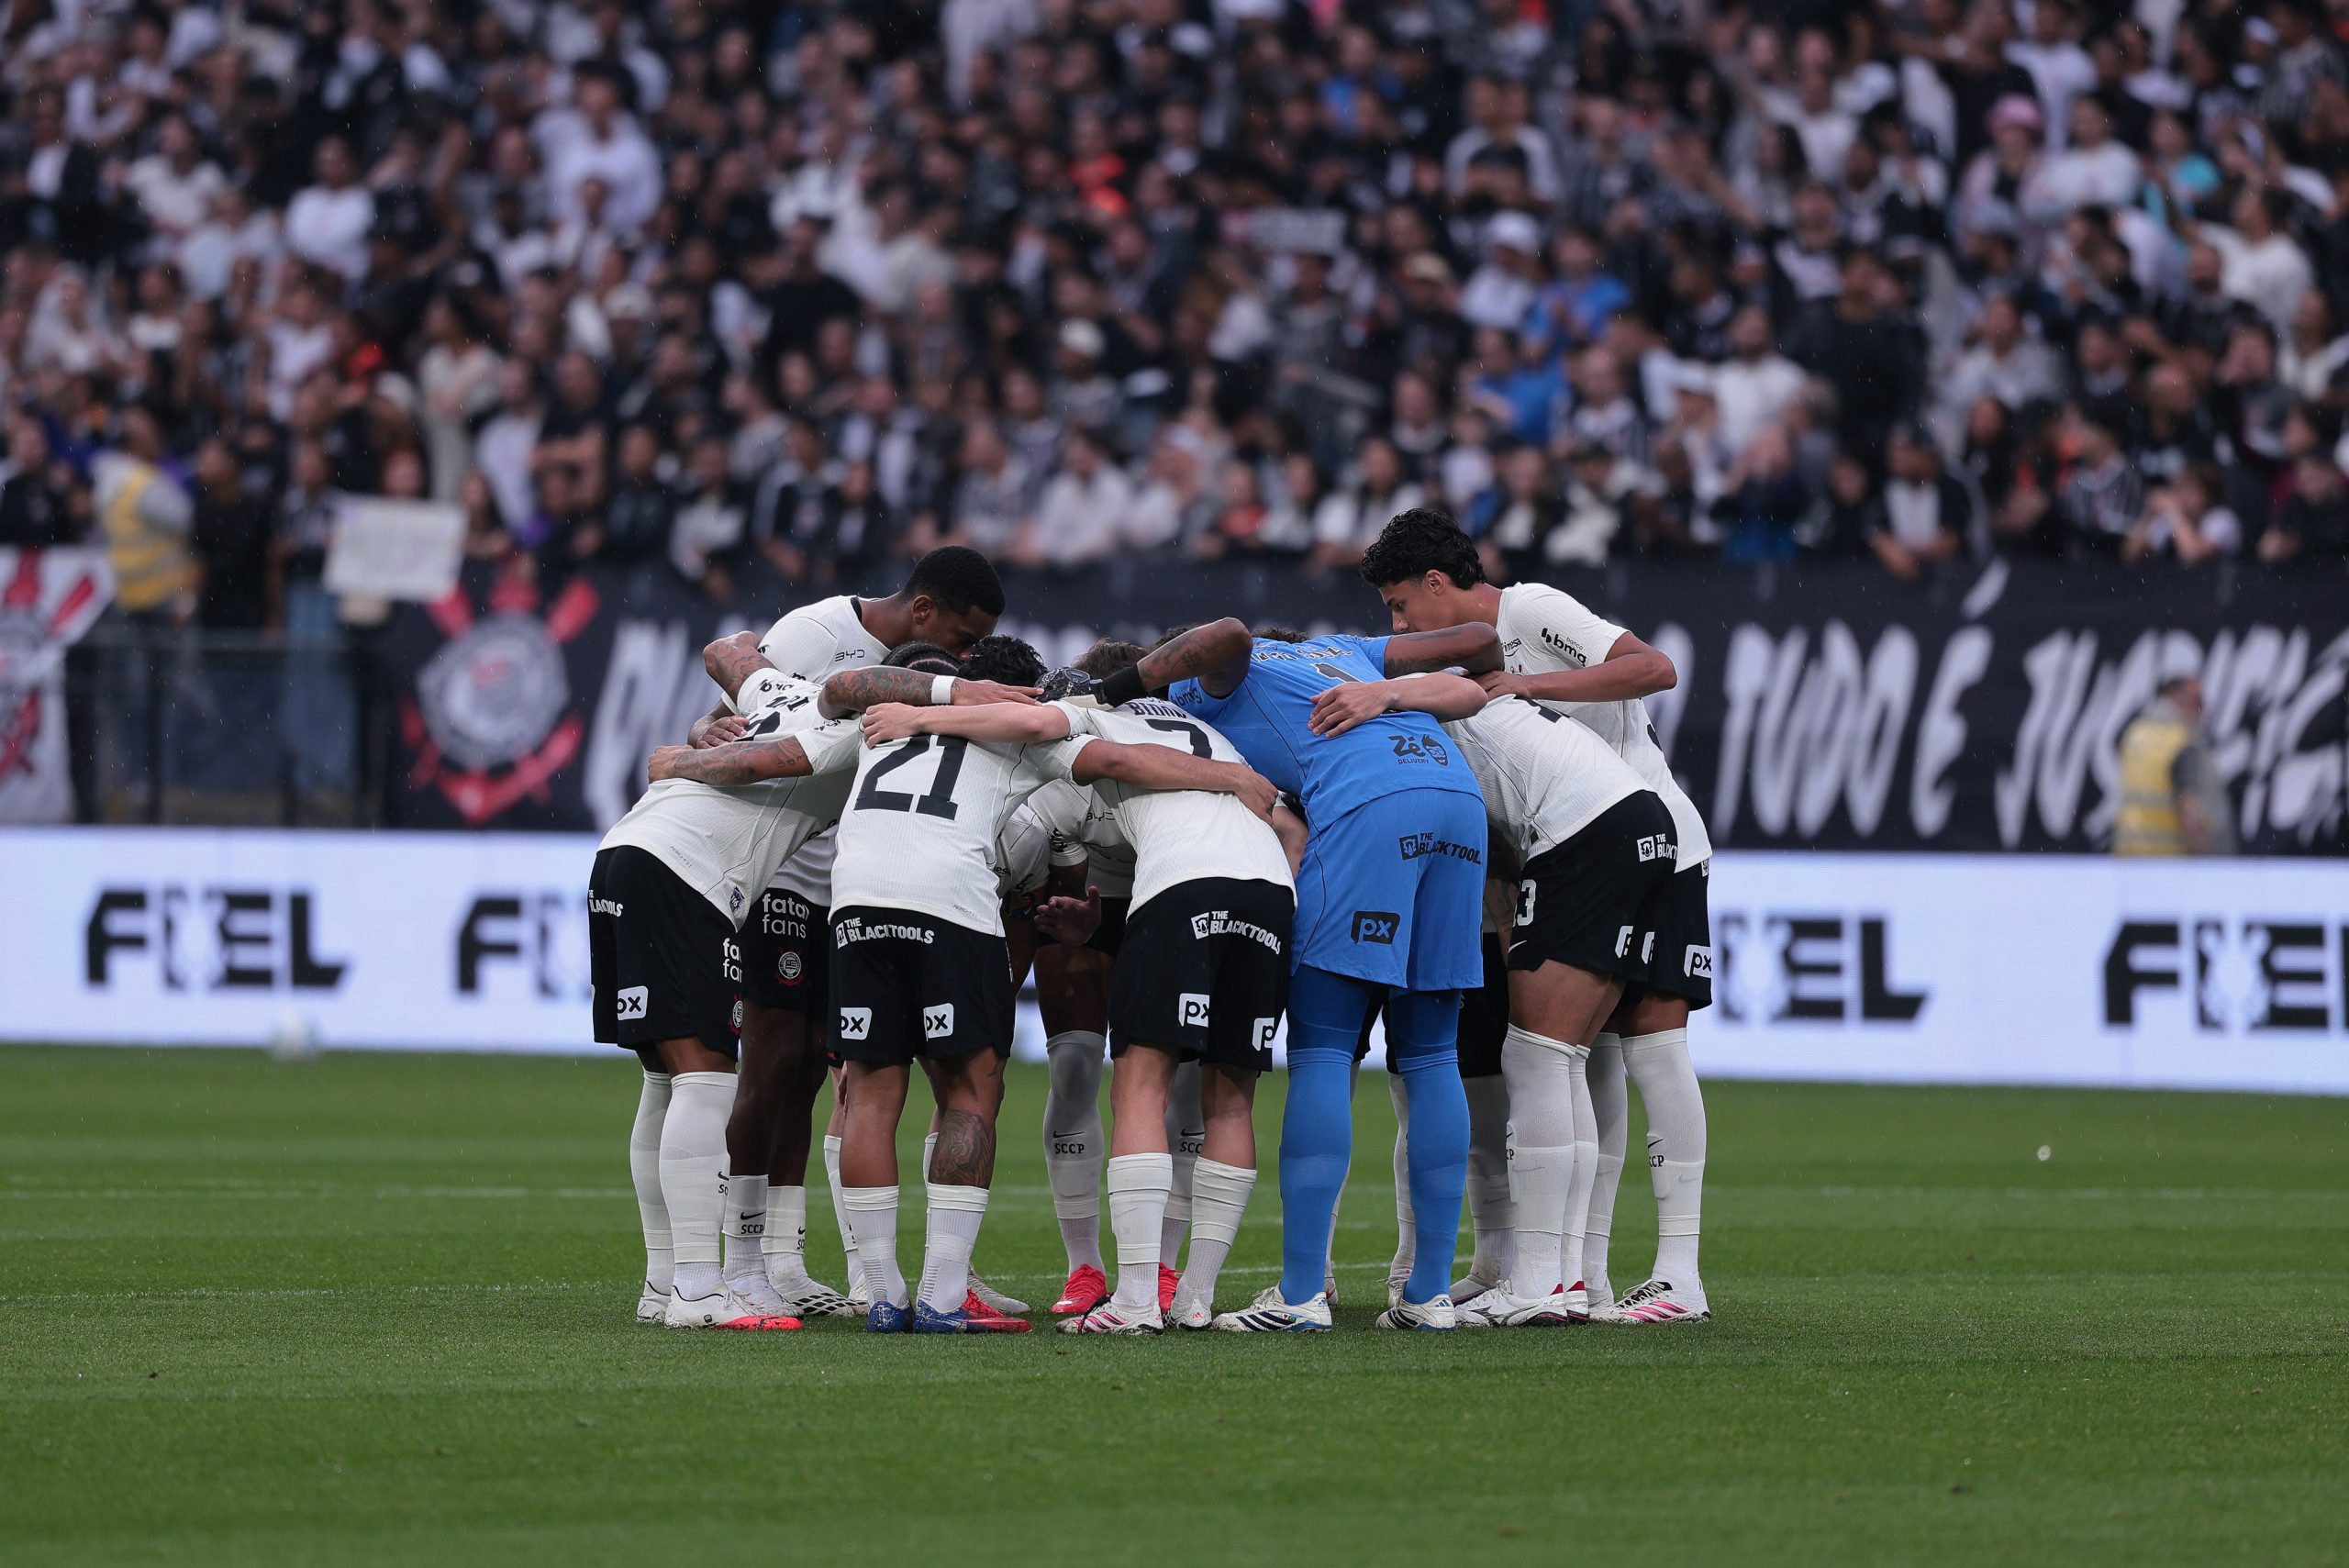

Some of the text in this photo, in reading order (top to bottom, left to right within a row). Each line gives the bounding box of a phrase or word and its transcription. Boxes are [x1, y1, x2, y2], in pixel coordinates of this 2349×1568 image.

[834, 649, 865, 662] BYD
[853, 734, 969, 821] 21
[1419, 831, 1434, 842] THE
[1654, 832, 1666, 843] THE
[1211, 910, 1230, 920] THE
[762, 914, 807, 939] fans
[844, 917, 862, 929] THE
[2103, 921, 2349, 1031] FIE
[1054, 1142, 1085, 1154] SCCP
[1179, 1140, 1203, 1154] SCC
[740, 1224, 764, 1235] SCCP
